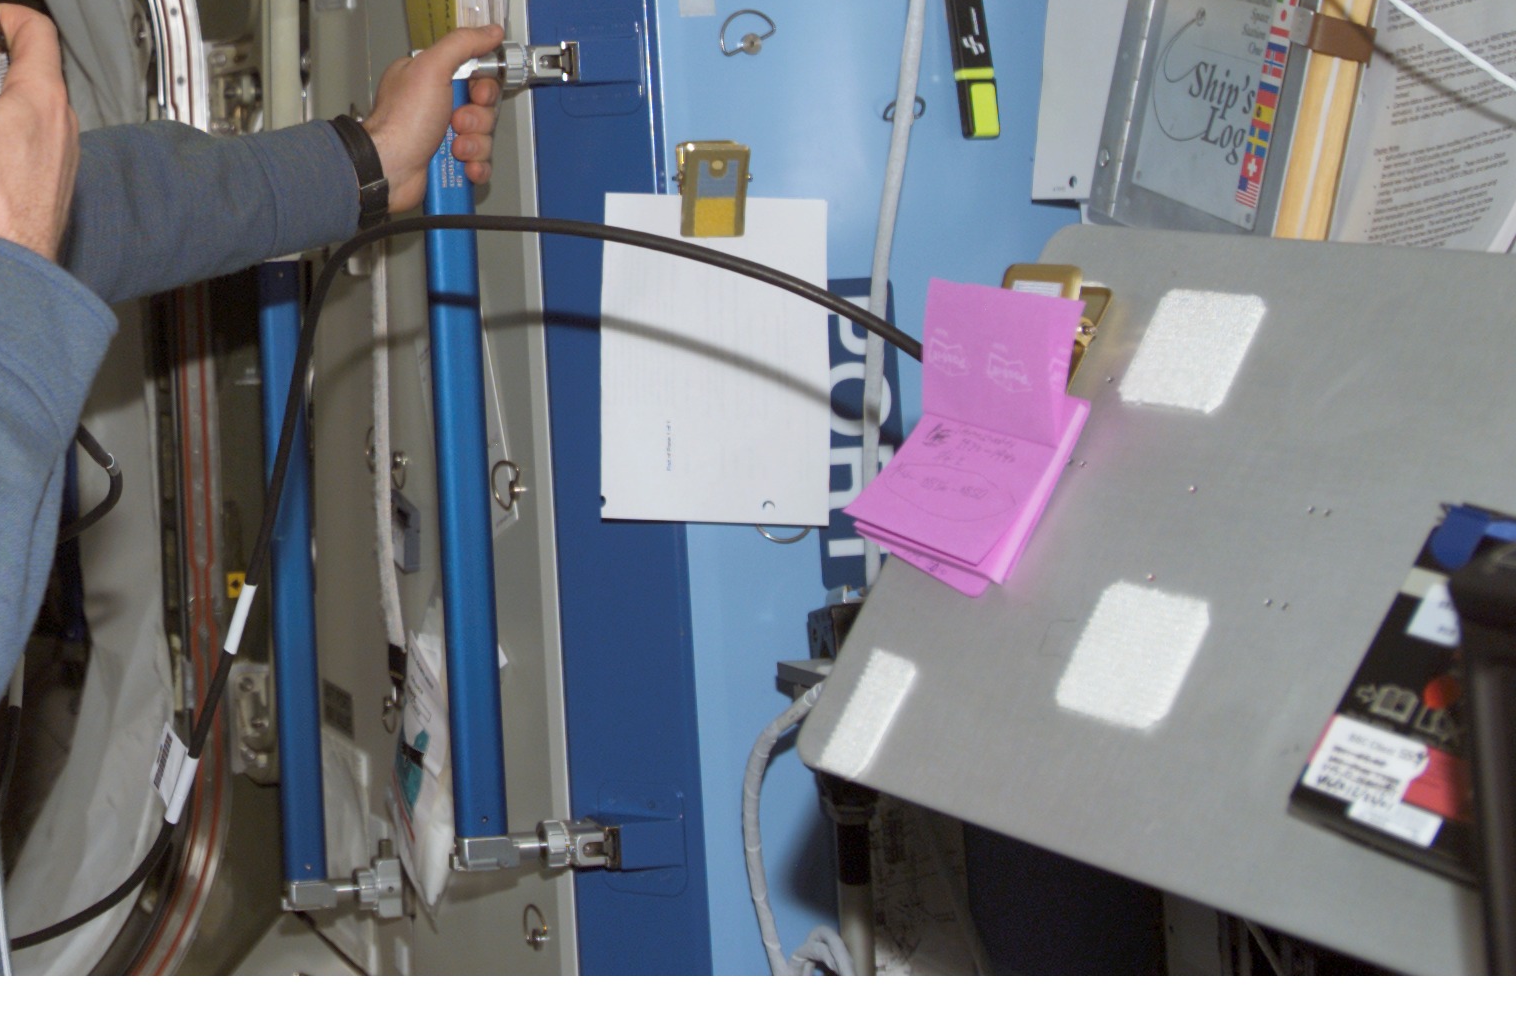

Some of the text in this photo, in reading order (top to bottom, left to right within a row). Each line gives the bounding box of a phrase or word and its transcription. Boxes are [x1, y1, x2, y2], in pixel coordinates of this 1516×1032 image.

[1240, 24, 1267, 40] Station
[1250, 7, 1269, 24] Space
[1188, 61, 1256, 120] Ship's
[1200, 106, 1247, 166] Log
